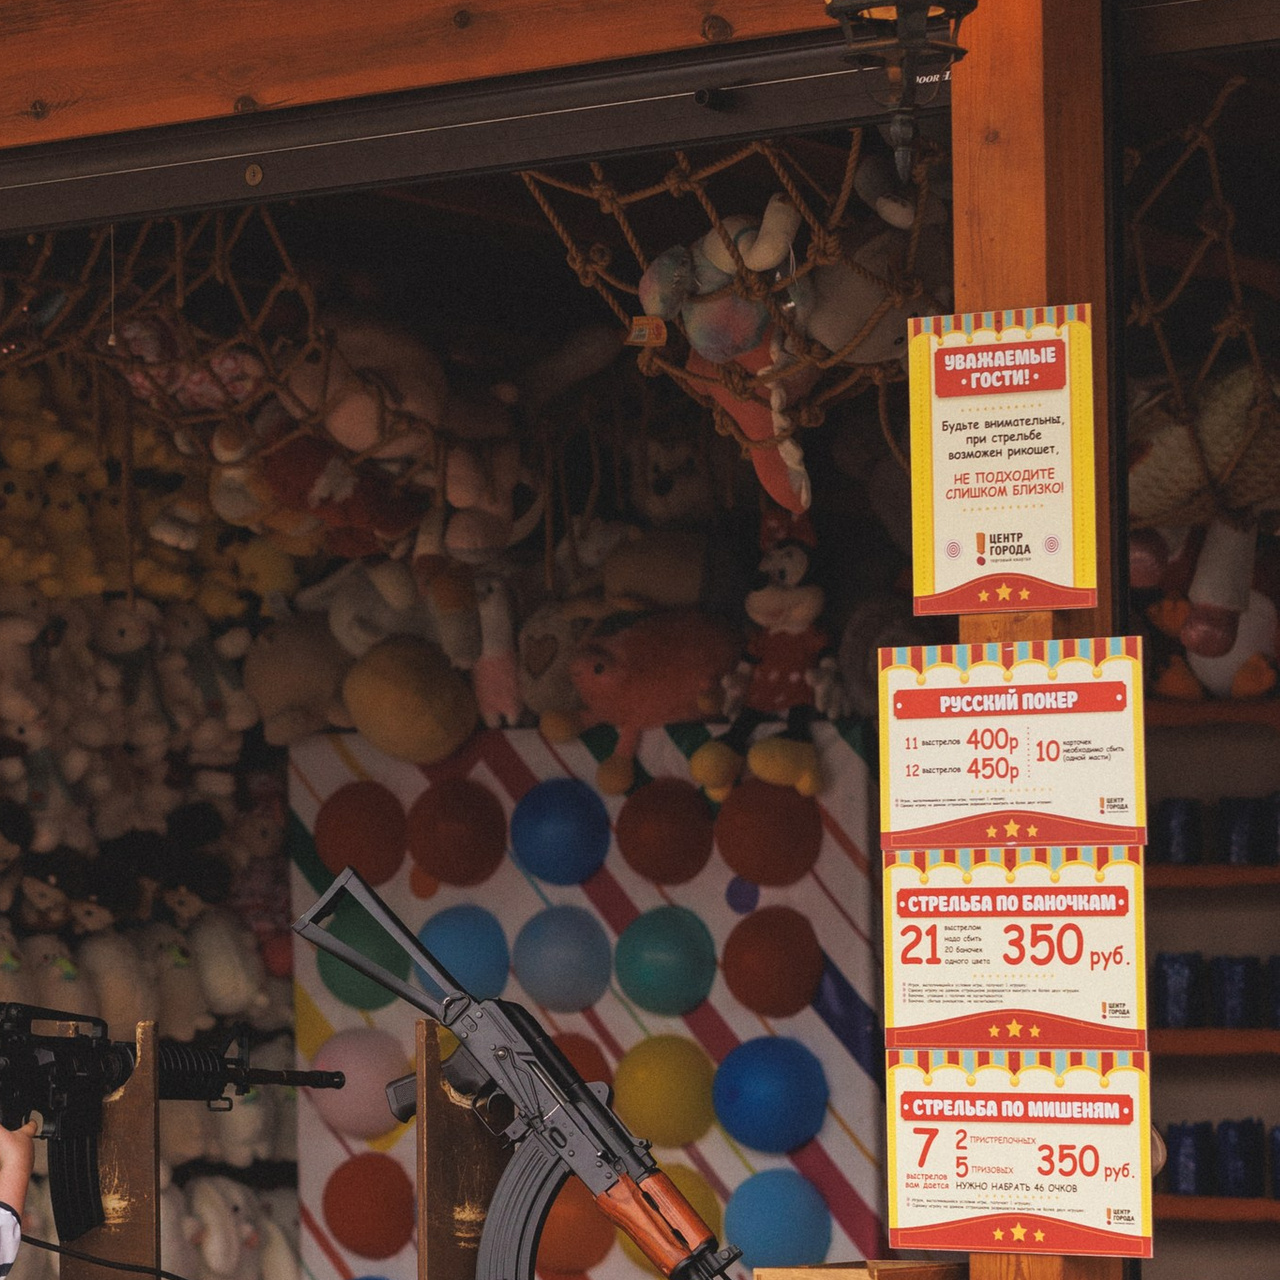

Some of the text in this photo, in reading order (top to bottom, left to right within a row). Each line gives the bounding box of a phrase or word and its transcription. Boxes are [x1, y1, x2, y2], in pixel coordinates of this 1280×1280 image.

[944, 346, 1056, 371] УВАЖАЕМЫЕ
[970, 368, 1030, 389] ГОСТИ!
[941, 415, 1065, 434] Будьте внимательны,
[966, 429, 1042, 447] при стрельбе
[948, 445, 1059, 460] возможен рикошет,
[954, 467, 1055, 485] НЕ ПОДХОДИТЕ
[946, 482, 1064, 500] СЛИШКОМ БЛИЗКО!
[989, 532, 1023, 544] ЦЕНТР
[990, 544, 1031, 556] ГОРОДА
[939, 688, 1078, 713] РУССКИЙ ПОКЕР
[905, 727, 1019, 755] 11 выстрелов 400р
[1036, 739, 1060, 762] 10
[905, 756, 1019, 784] 12 выстрелов 450р
[908, 894, 1116, 912] СТРЕЛЬБА ПО БАНОЧКАМ
[900, 924, 942, 965] 21
[1003, 923, 1130, 971] 350 руб.
[913, 1099, 1120, 1119] СТРЕЛЬБА ПО МИШЕНЯМ
[913, 1127, 939, 1168] 7
[955, 1128, 1037, 1150] 2 ПРИСТРЕЛОЧНЫХ
[955, 1156, 1014, 1178] 5 ПРИЗОВЫХ
[1037, 1144, 1135, 1182] 350 руб.
[906, 1173, 948, 1181] выстрелов
[923, 1182, 949, 1190] дается
[956, 1182, 1078, 1192] НУЖНО НАБРАТЬ 46 ОЧКОВ
